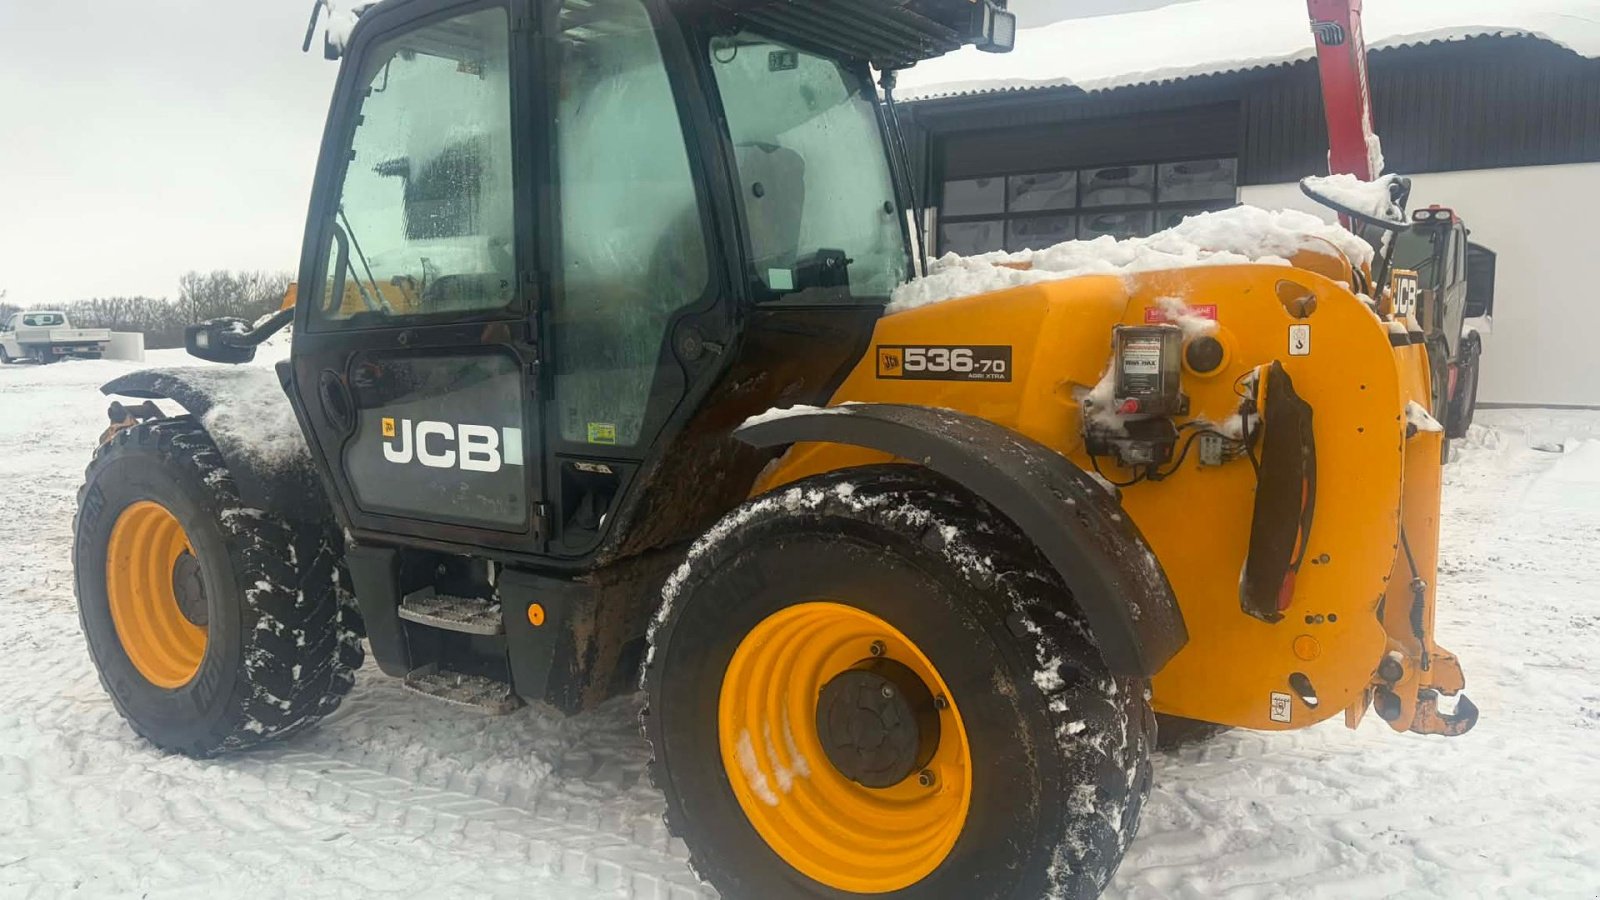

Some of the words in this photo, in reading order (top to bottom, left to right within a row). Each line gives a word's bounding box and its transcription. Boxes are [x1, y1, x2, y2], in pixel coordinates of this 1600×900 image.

[1394, 278, 1417, 315] JCB
[904, 348, 1006, 372] 536-70
[382, 419, 502, 473] JCB
